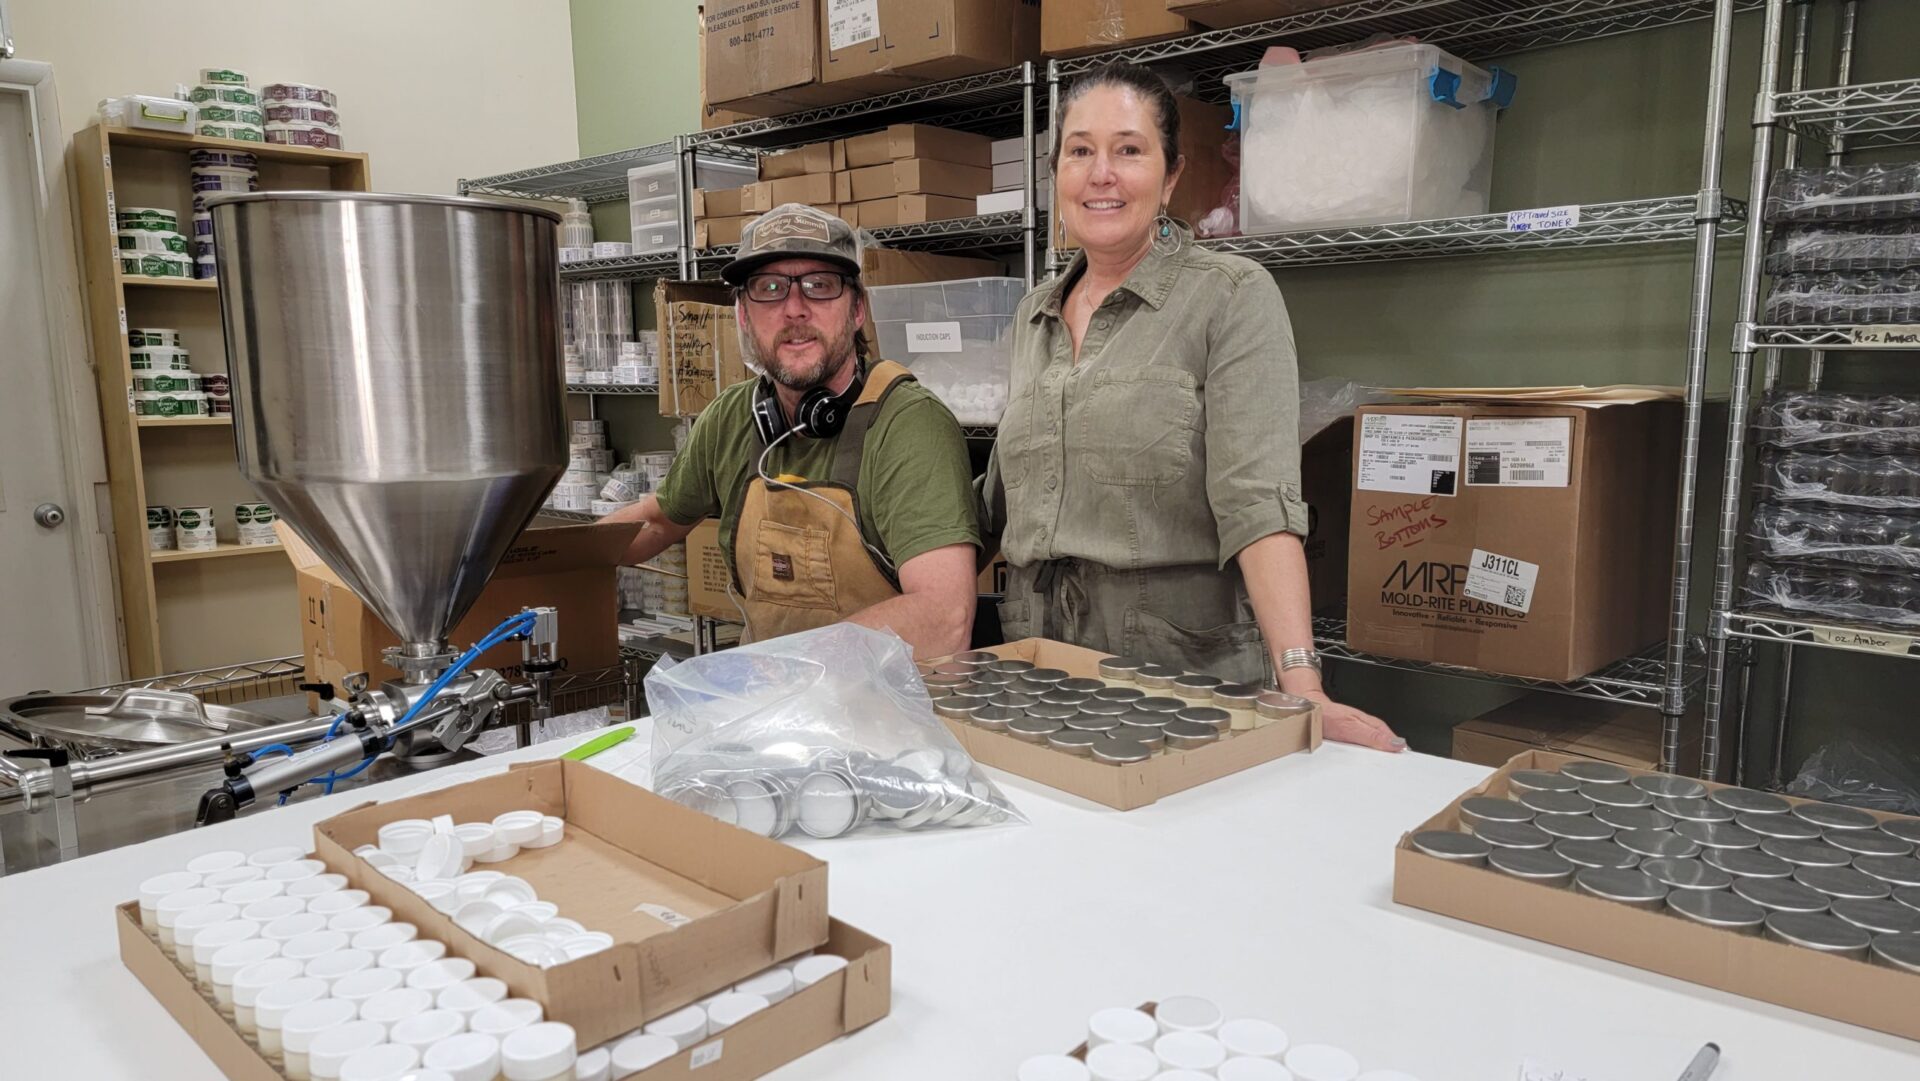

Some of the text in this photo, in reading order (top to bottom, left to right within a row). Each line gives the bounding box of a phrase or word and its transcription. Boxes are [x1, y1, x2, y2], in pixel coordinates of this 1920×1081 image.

[705, 16, 716, 25] FOR
[716, 5, 746, 20] COMMENTS
[746, 2, 759, 12] AND
[707, 21, 728, 33] PLEASE
[727, 18, 741, 28] CALL
[773, 1, 801, 14] SERVICE
[729, 26, 775, 48] 800-421-4772
[793, 216, 825, 230] Summit
[1537, 217, 1572, 229] TONER
[916, 333, 951, 341] INDUCTION CAPS
[1367, 495, 1440, 526] SAMPLE
[1482, 553, 1520, 577] J311CL
[1381, 591, 1456, 611] MOLD-RITE
[1392, 609, 1518, 630] Innovative Reliable Responsive
[1853, 633, 1889, 647] Amber
